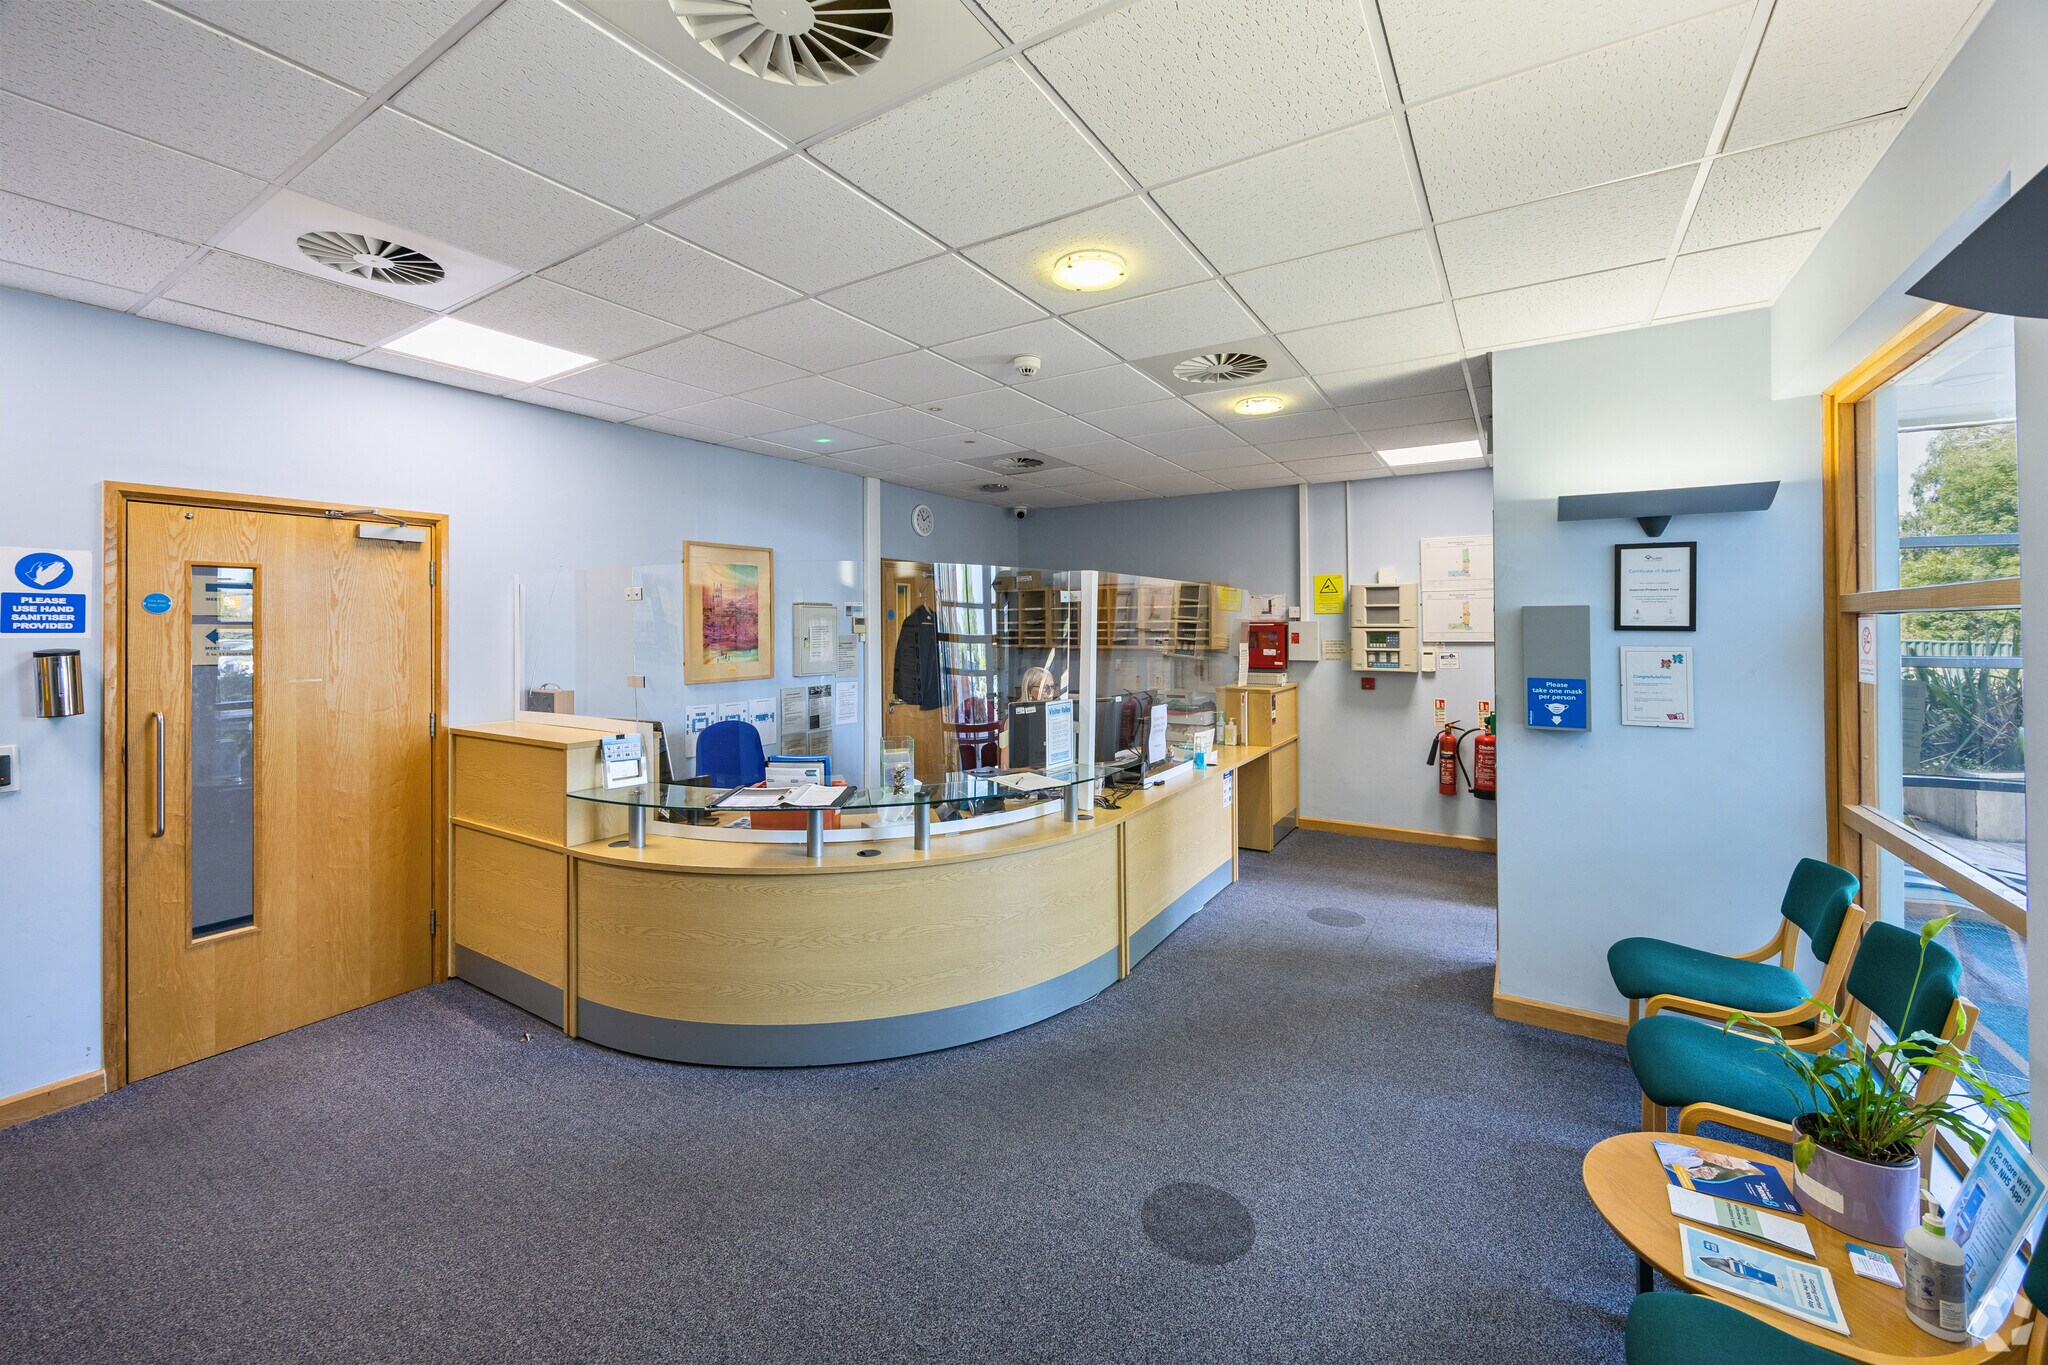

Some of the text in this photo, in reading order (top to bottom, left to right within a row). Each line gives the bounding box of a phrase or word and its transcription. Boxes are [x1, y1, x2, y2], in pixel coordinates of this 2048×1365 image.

[1989, 1156, 2026, 1206] the NHS App!
[1994, 1145, 2031, 1197] Do more with
